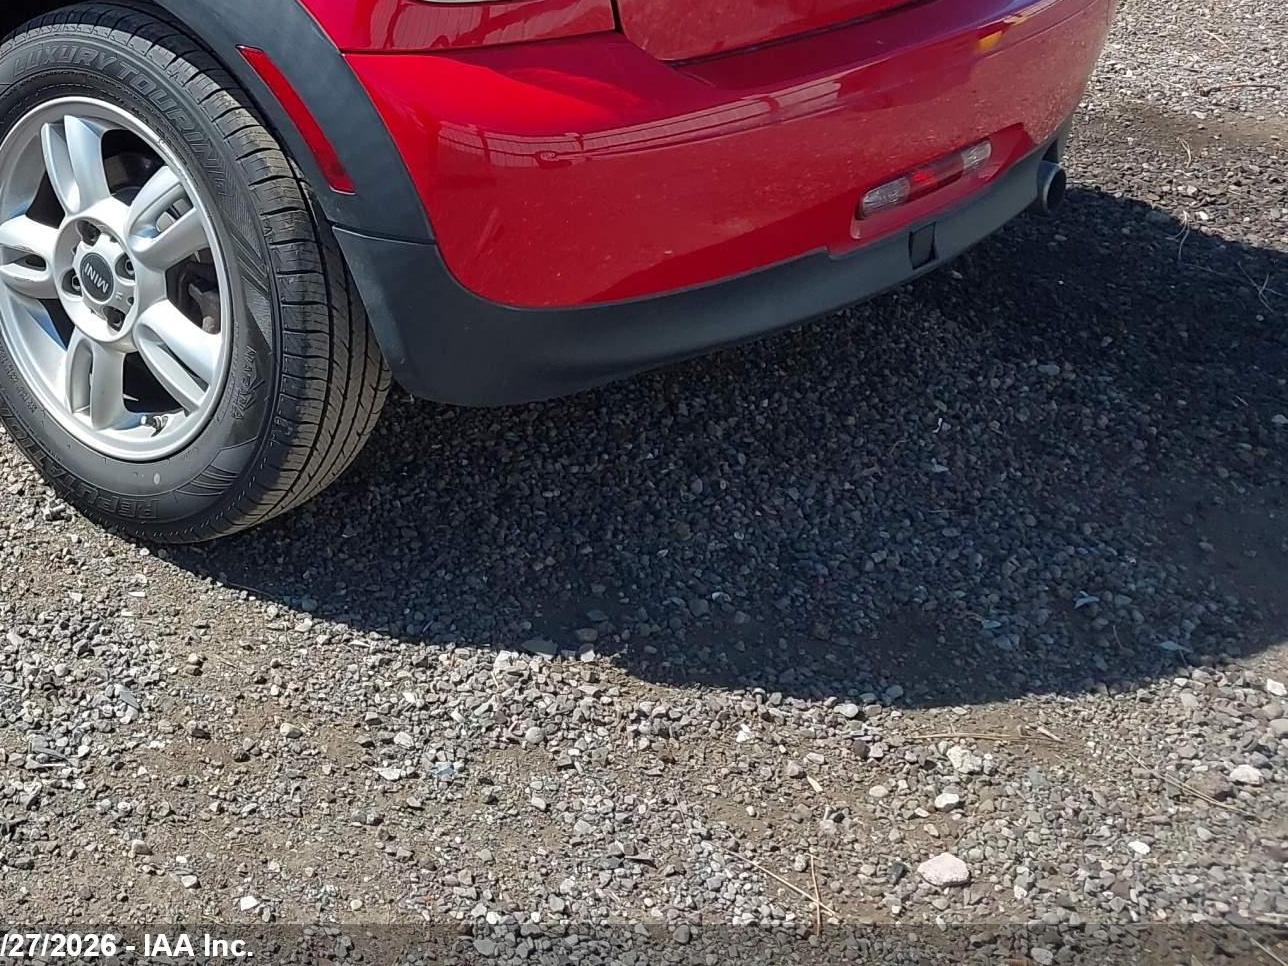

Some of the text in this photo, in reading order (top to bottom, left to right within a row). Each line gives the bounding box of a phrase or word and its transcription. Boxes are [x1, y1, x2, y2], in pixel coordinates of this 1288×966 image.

[14, 44, 233, 197] LUXURY TOURING
[84, 262, 109, 294] MINI
